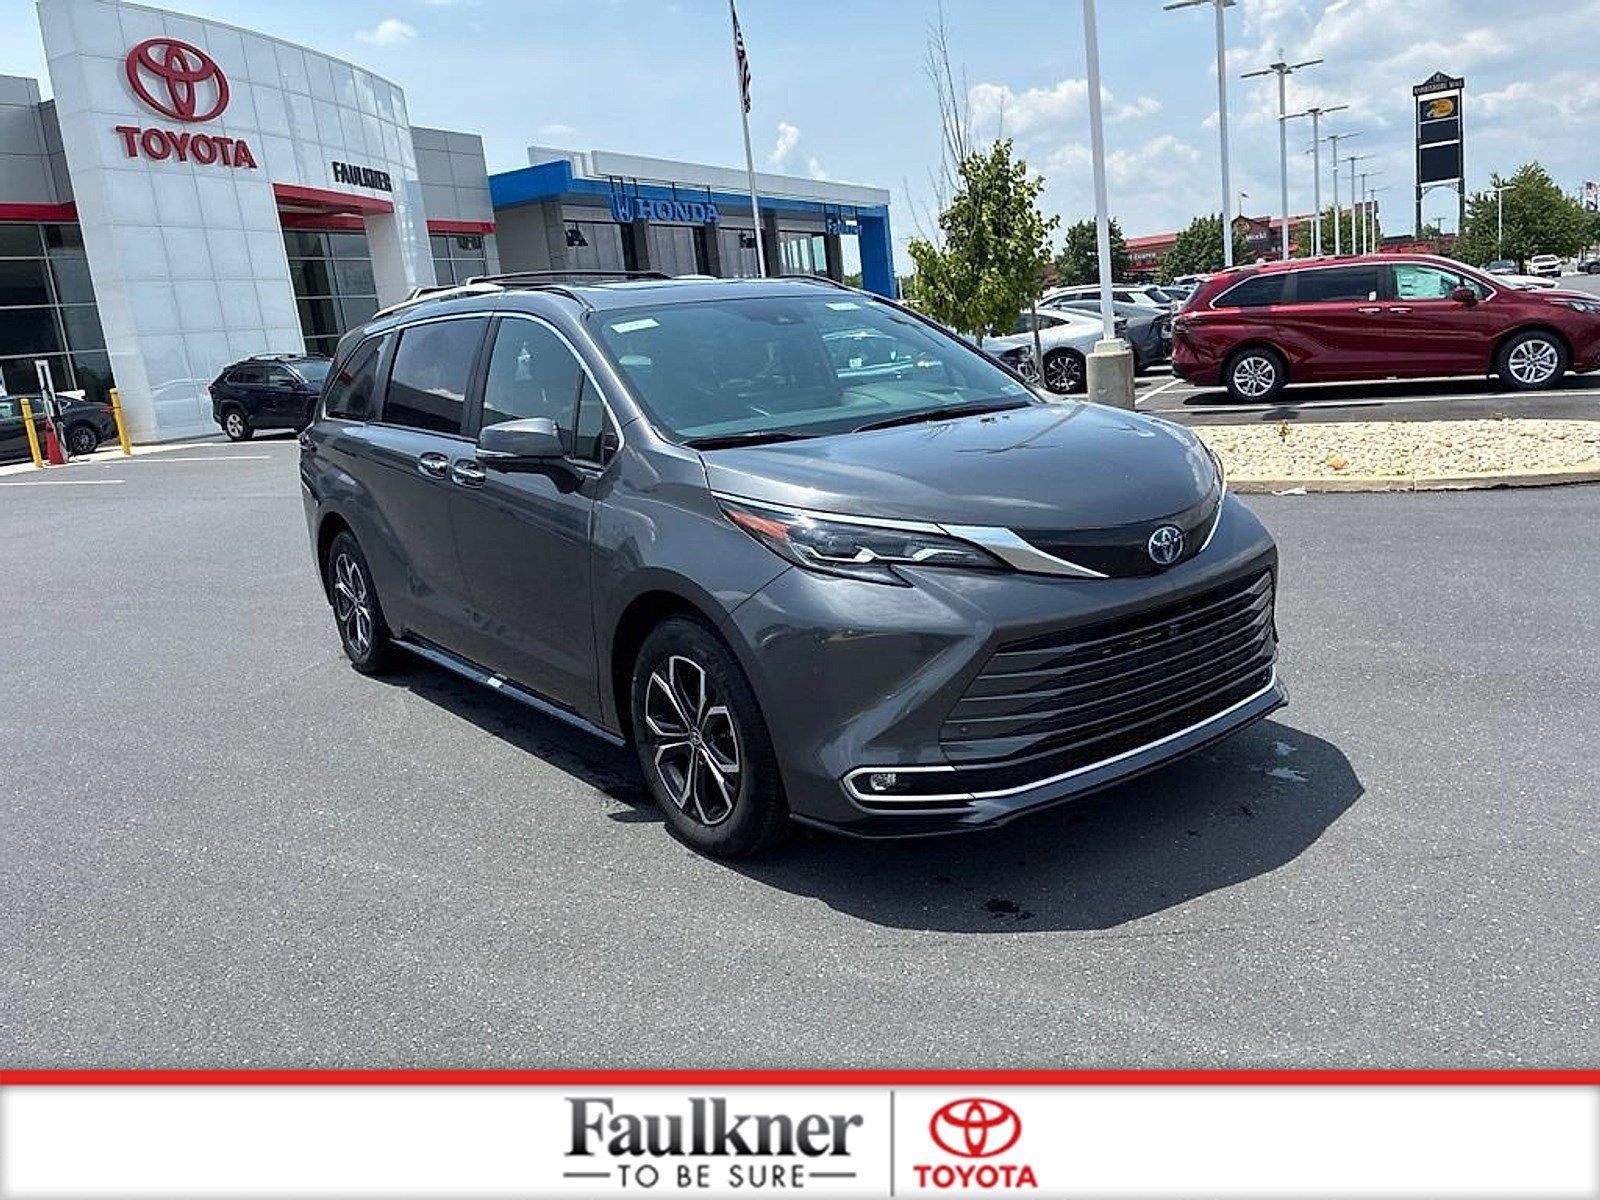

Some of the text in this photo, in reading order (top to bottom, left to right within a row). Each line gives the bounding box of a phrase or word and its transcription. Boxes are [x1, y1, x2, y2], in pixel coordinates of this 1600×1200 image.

[116, 125, 257, 168] TOYOTA
[332, 161, 391, 191] FAULKNER
[636, 198, 720, 223] HONDA
